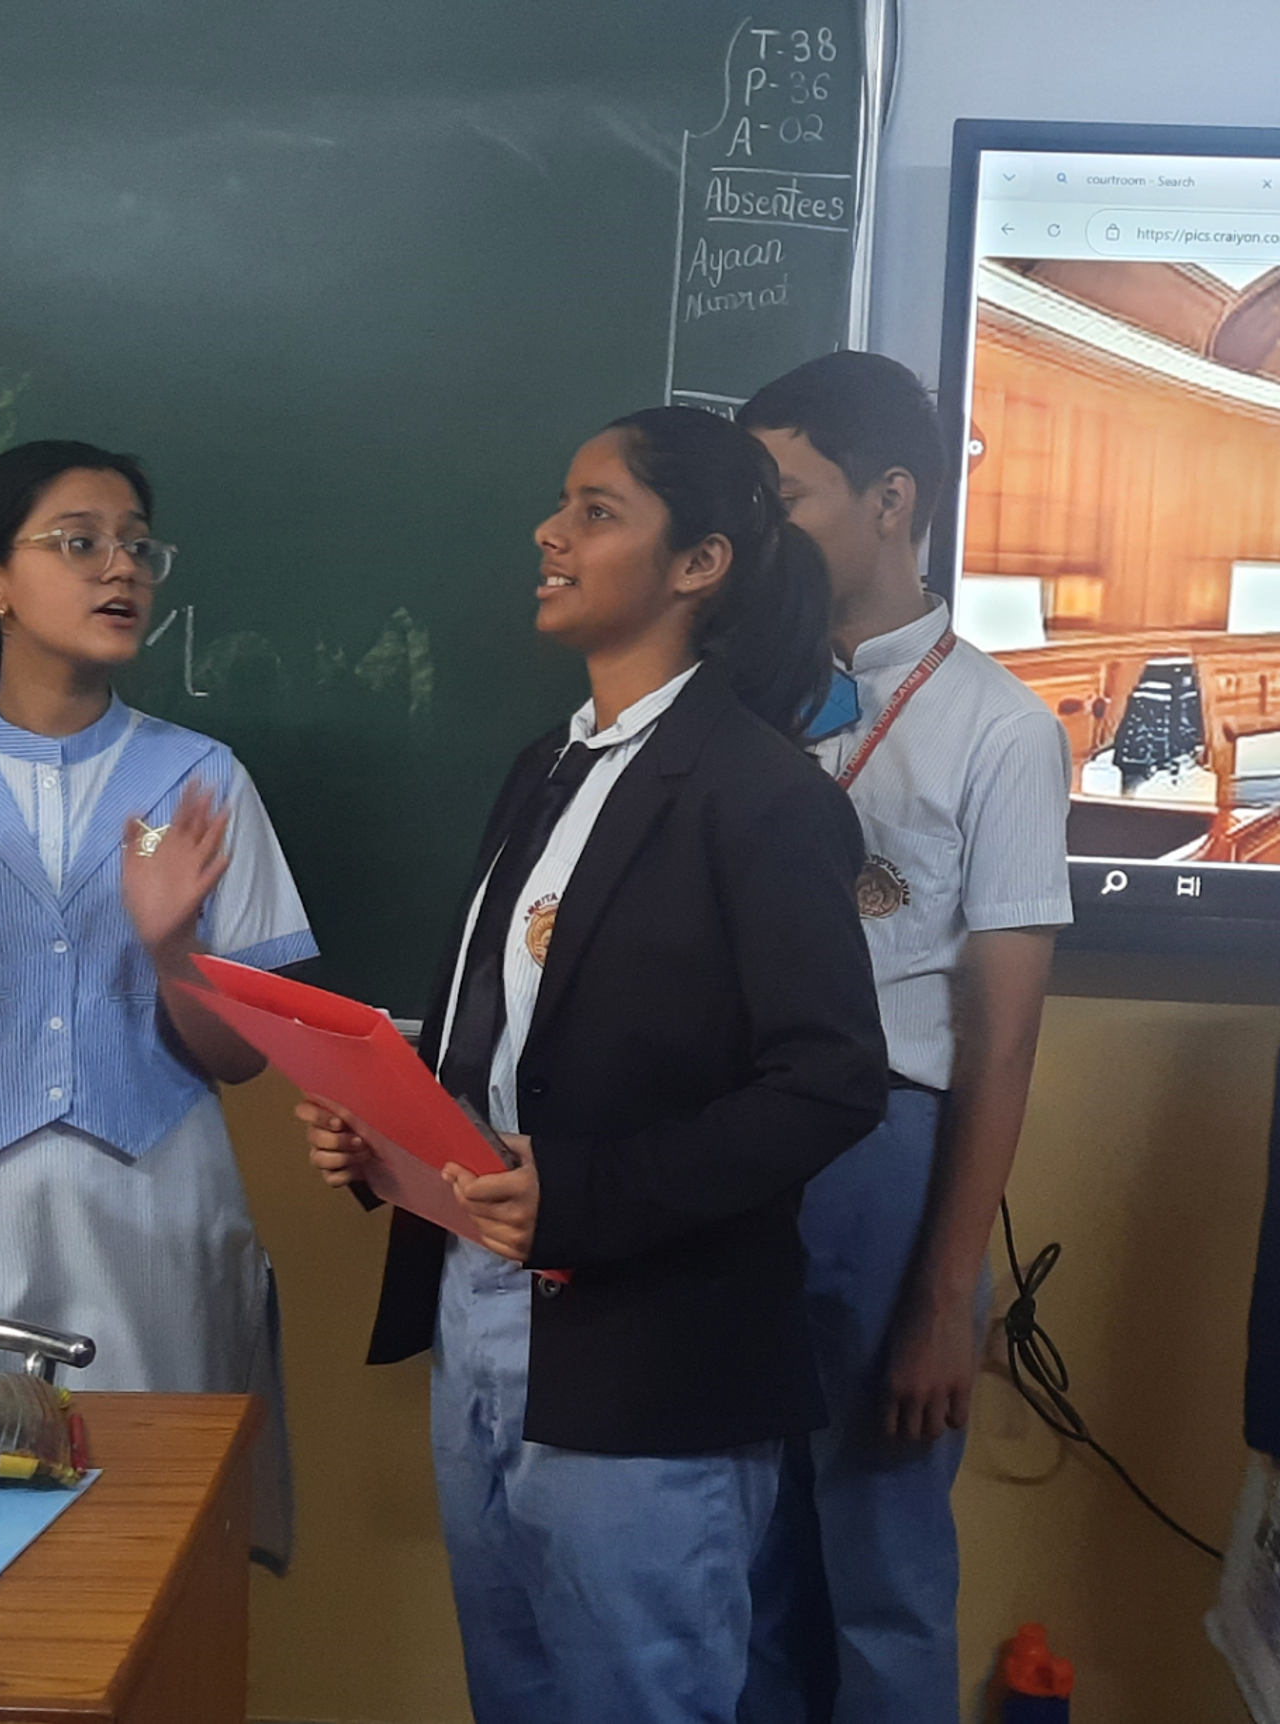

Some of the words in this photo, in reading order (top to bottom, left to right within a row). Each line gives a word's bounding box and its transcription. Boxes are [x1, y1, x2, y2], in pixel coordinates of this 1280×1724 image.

[704, 178, 844, 221] Absentees
[1085, 175, 1147, 187] courtroom
[1157, 175, 1196, 188] Search
[686, 238, 784, 288] Ayaan
